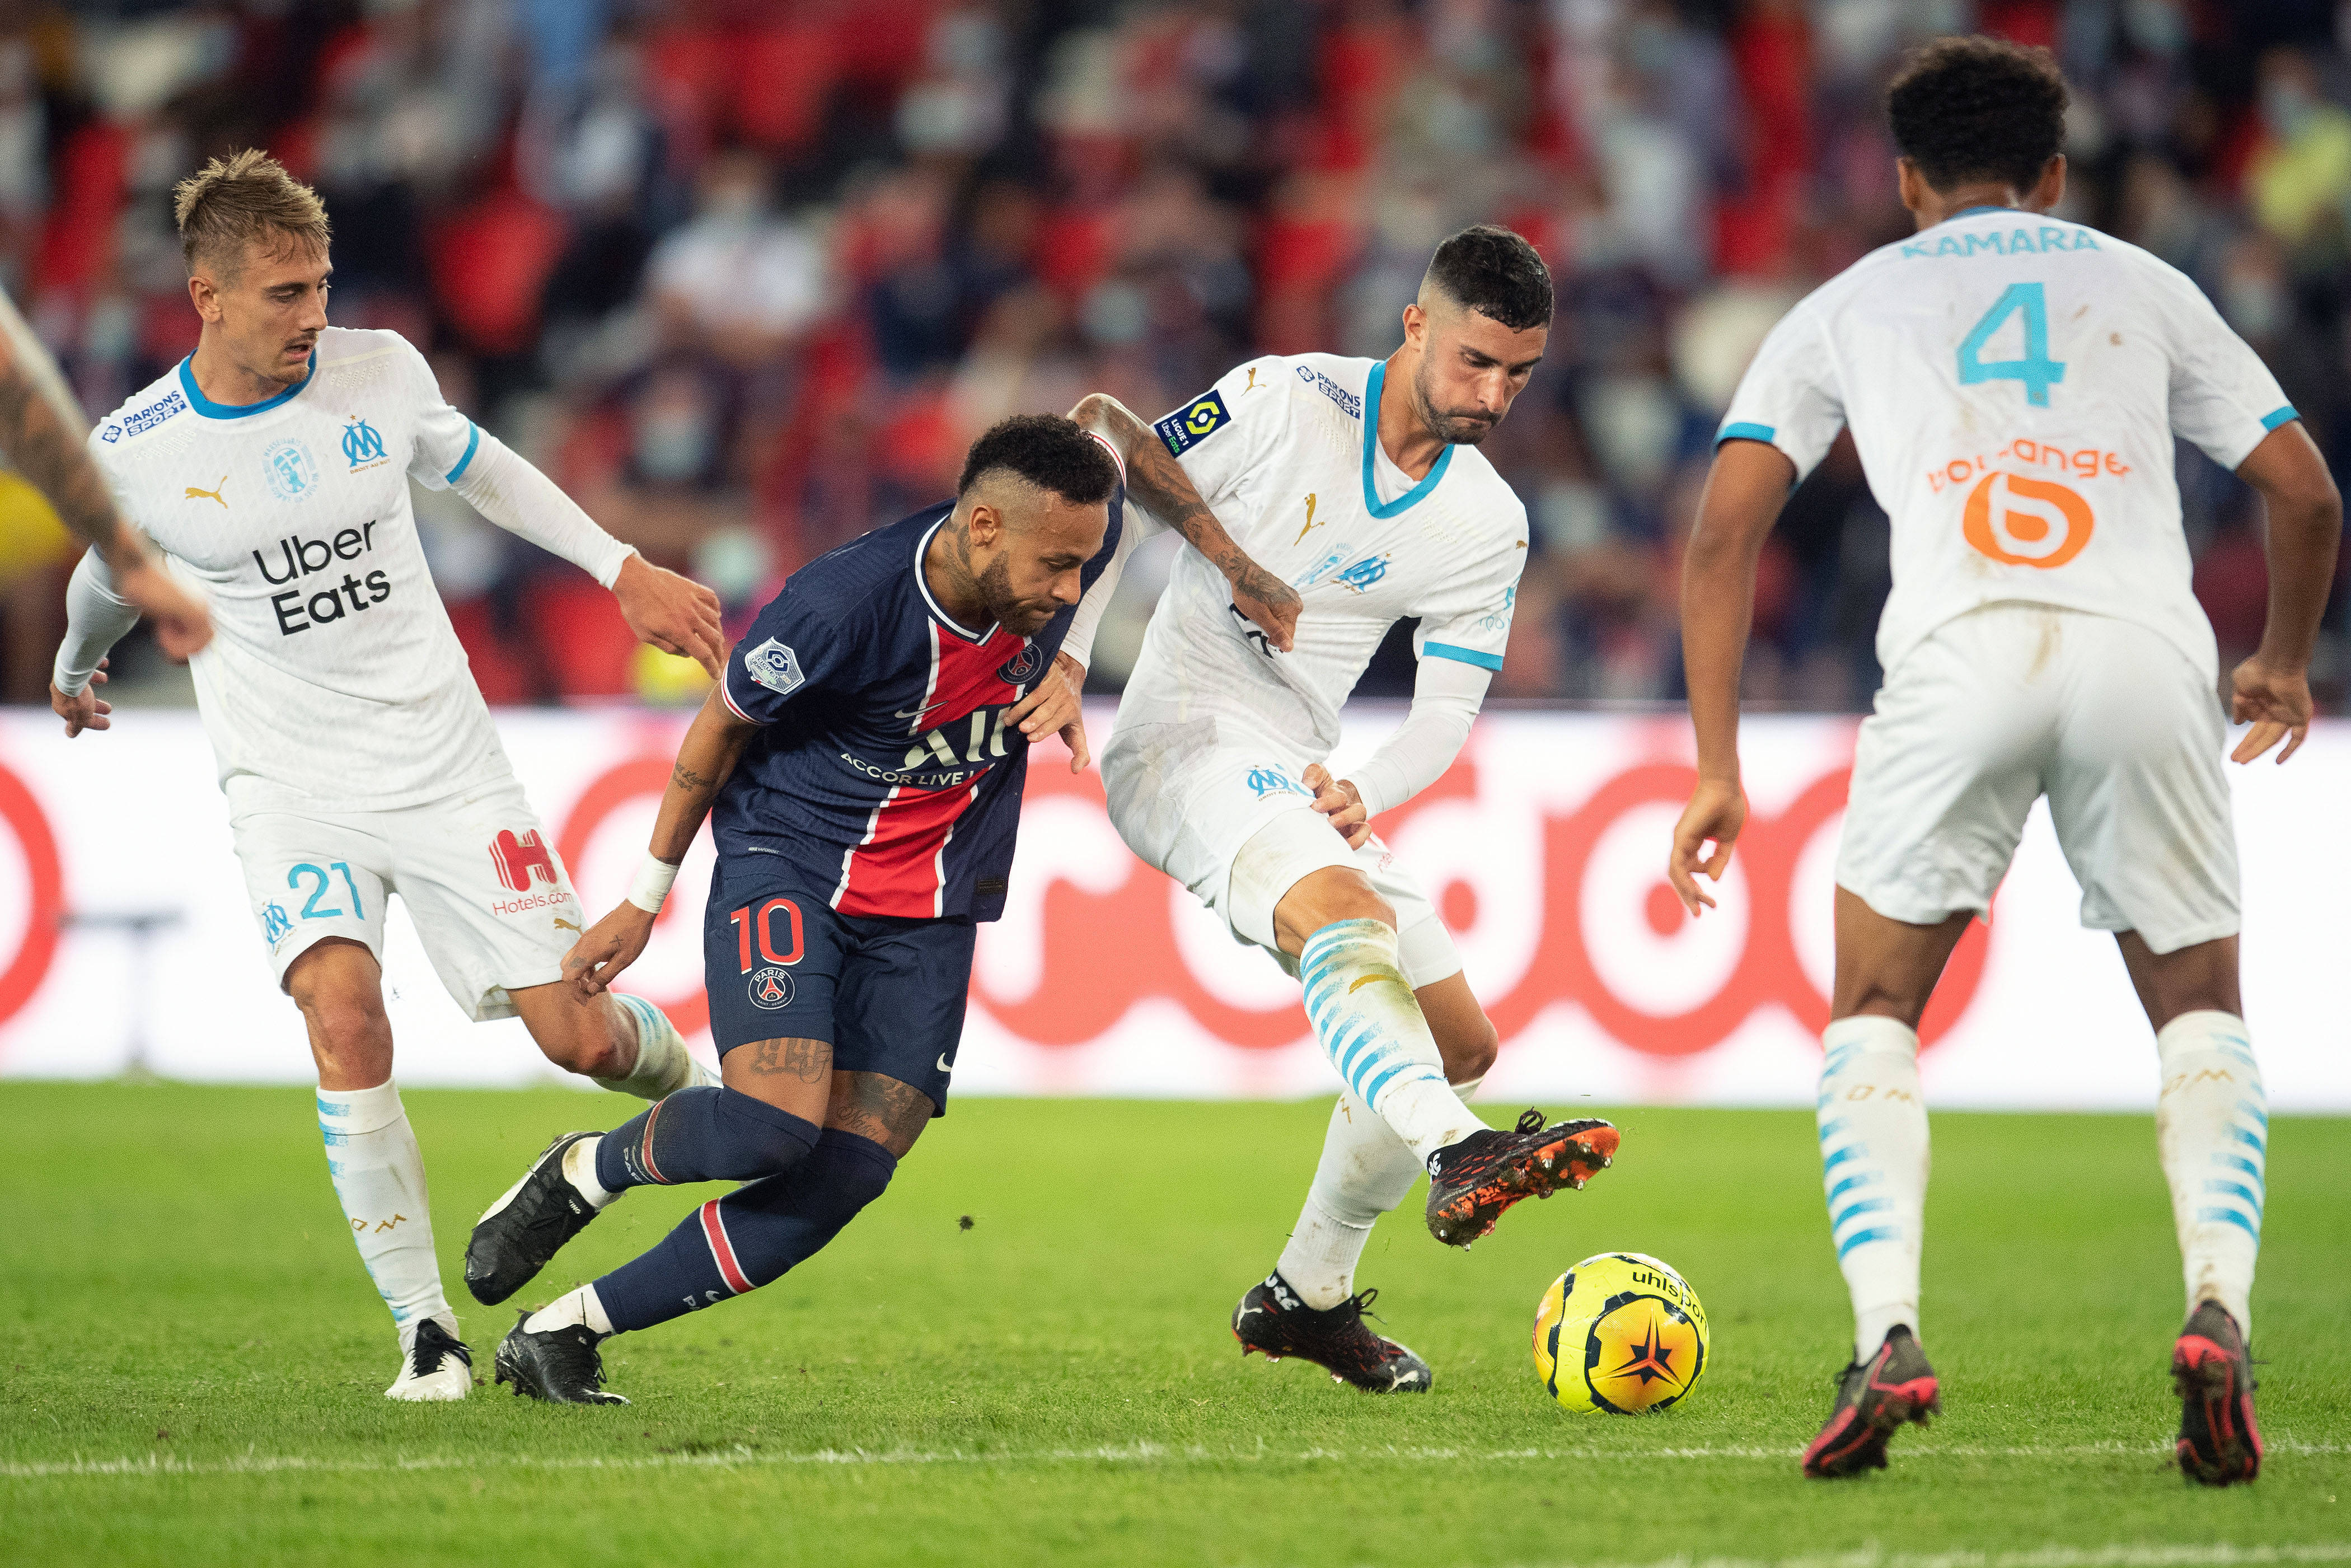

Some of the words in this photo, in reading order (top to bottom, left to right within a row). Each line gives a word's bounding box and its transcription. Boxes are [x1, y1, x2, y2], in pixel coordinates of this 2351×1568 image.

[1902, 226, 2102, 259] KAMARA
[1956, 282, 2068, 408] 4
[123, 390, 180, 427] PARIONS
[127, 400, 187, 437] SPORT
[1162, 422, 1172, 438] Uber
[1168, 436, 1180, 453] Eats
[1170, 419, 1187, 442] LIGUE
[252, 519, 376, 585] Uber
[271, 569, 391, 636] Eats
[840, 752, 912, 784] ACCOR
[918, 771, 964, 786] LIVE
[287, 862, 365, 920] 21
[492, 892, 573, 916] Hotels.com
[730, 898, 805, 975] 10
[754, 969, 785, 983] PARIS
